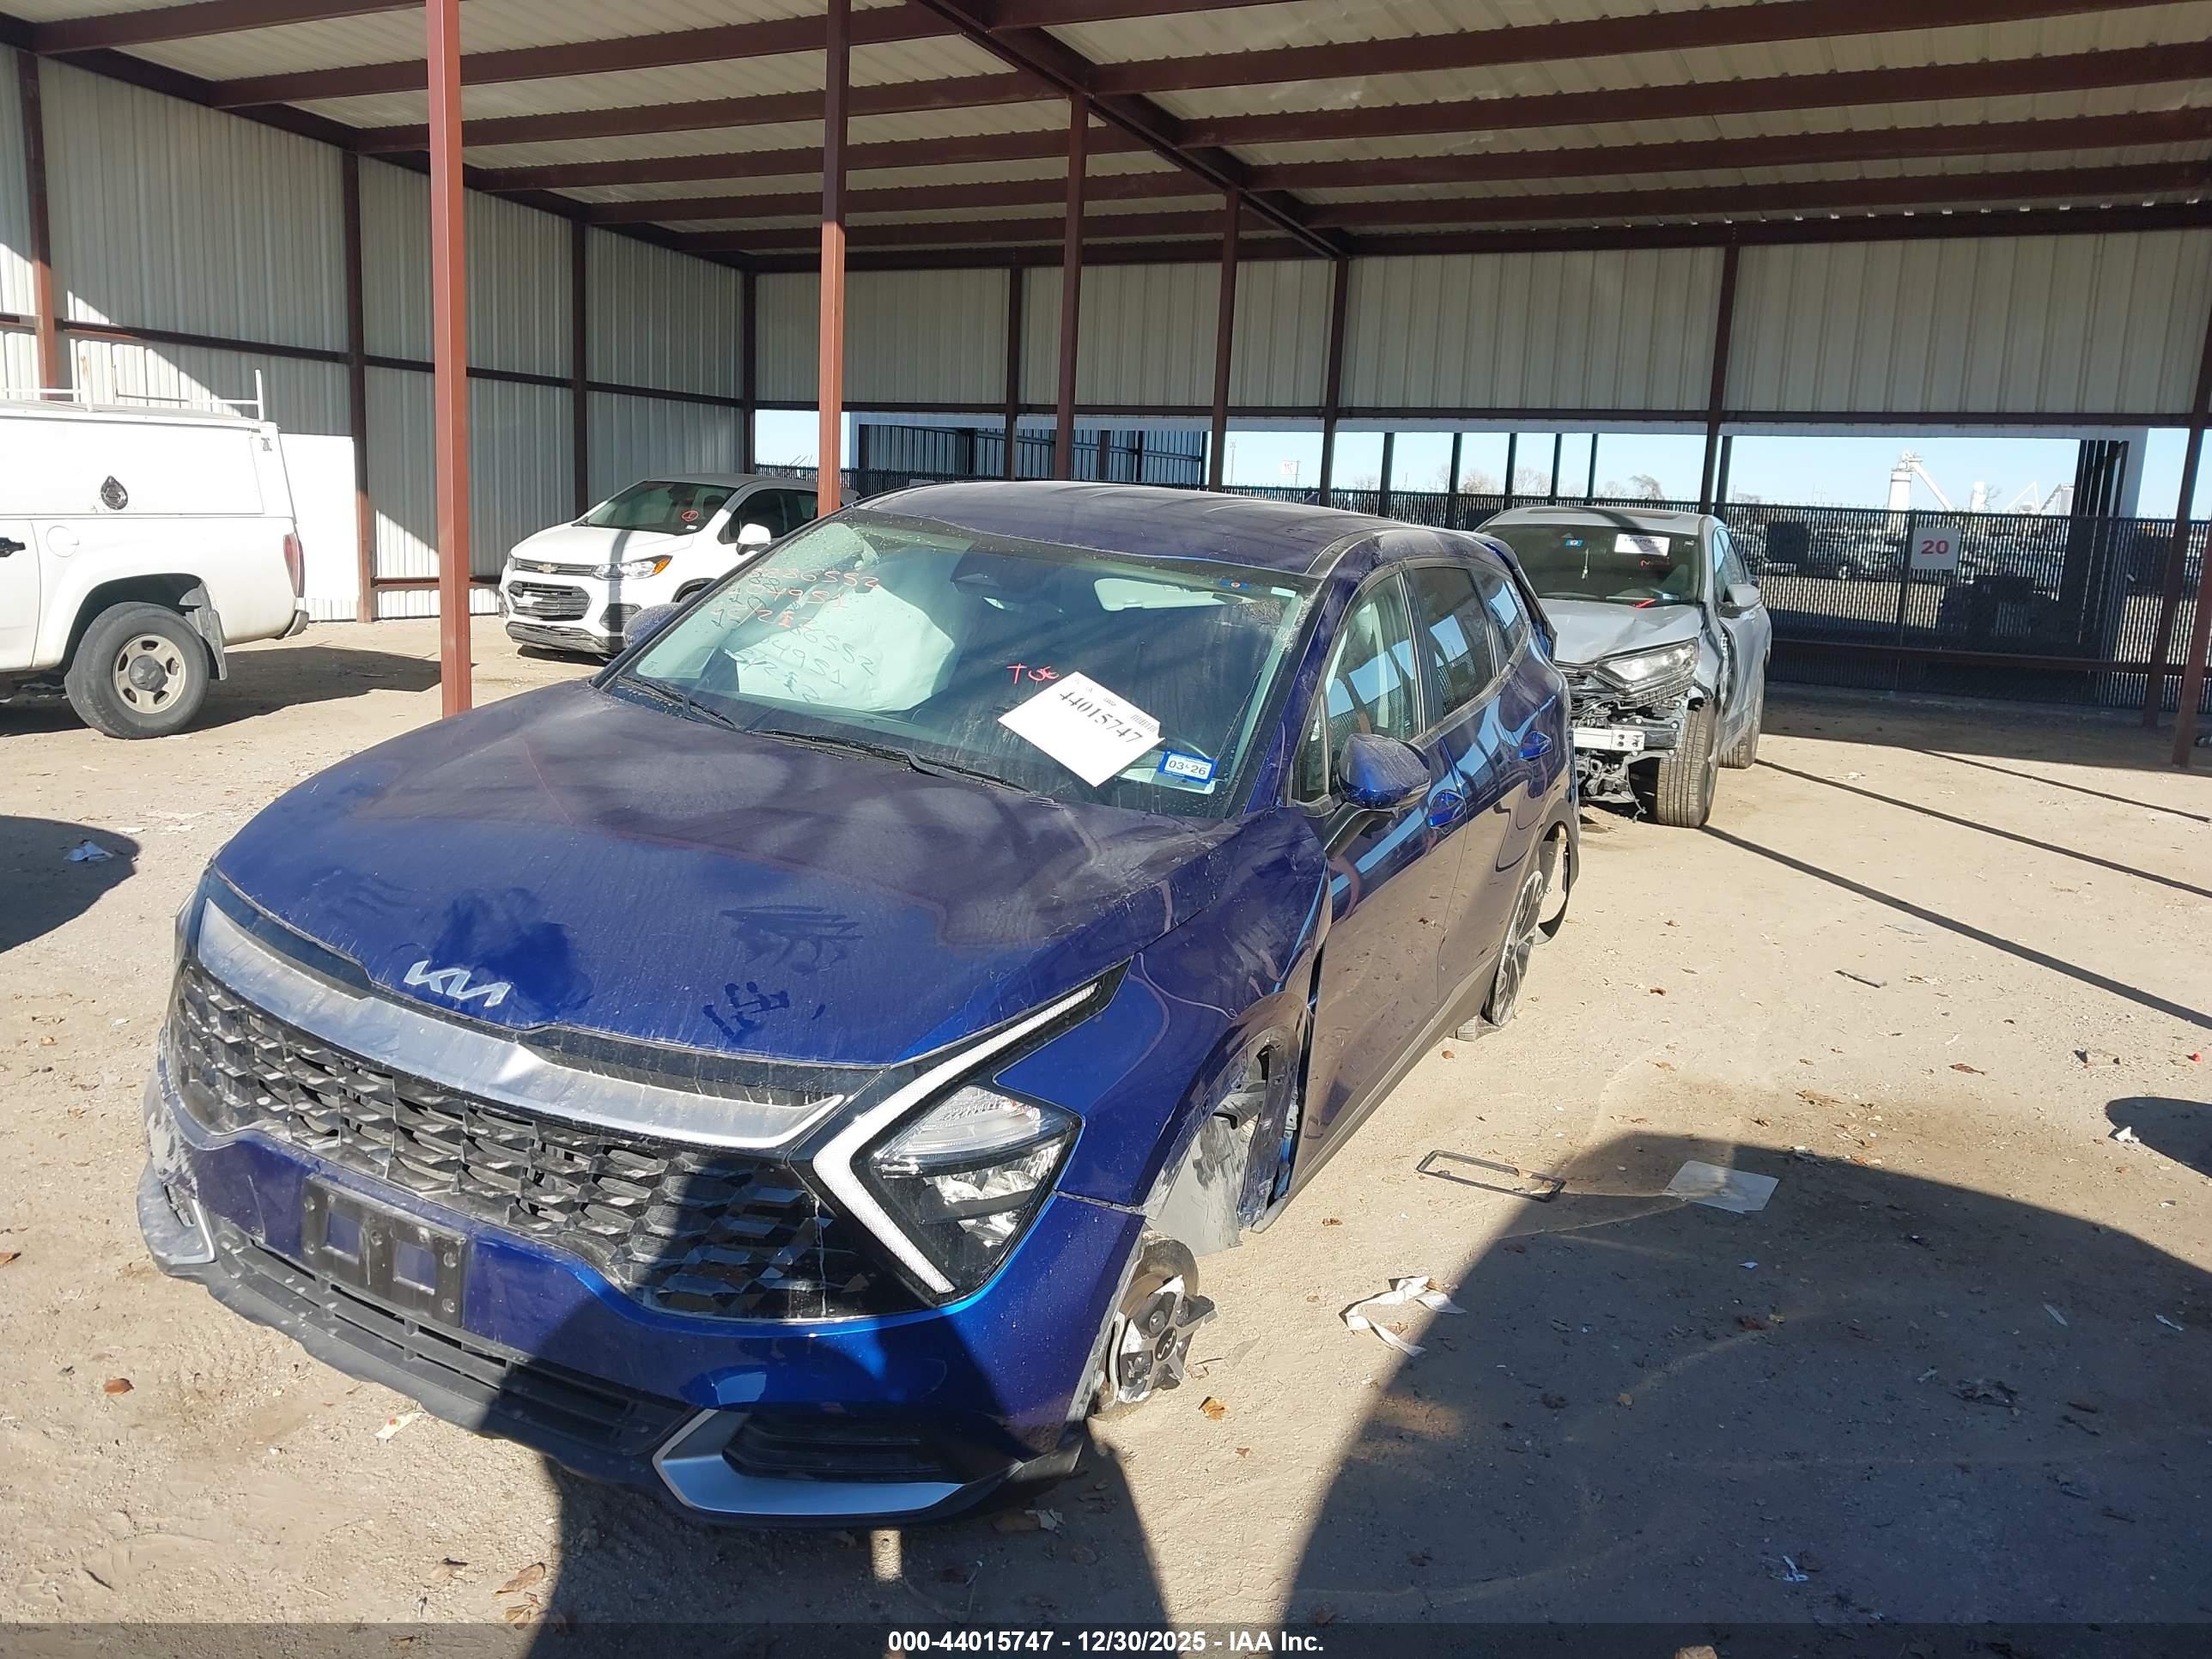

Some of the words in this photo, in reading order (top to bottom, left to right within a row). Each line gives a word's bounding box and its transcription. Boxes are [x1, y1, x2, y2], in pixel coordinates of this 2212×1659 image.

[1921, 539, 1950, 555] 20
[1006, 663, 1060, 684] TUE
[1059, 690, 1144, 743] 44015747
